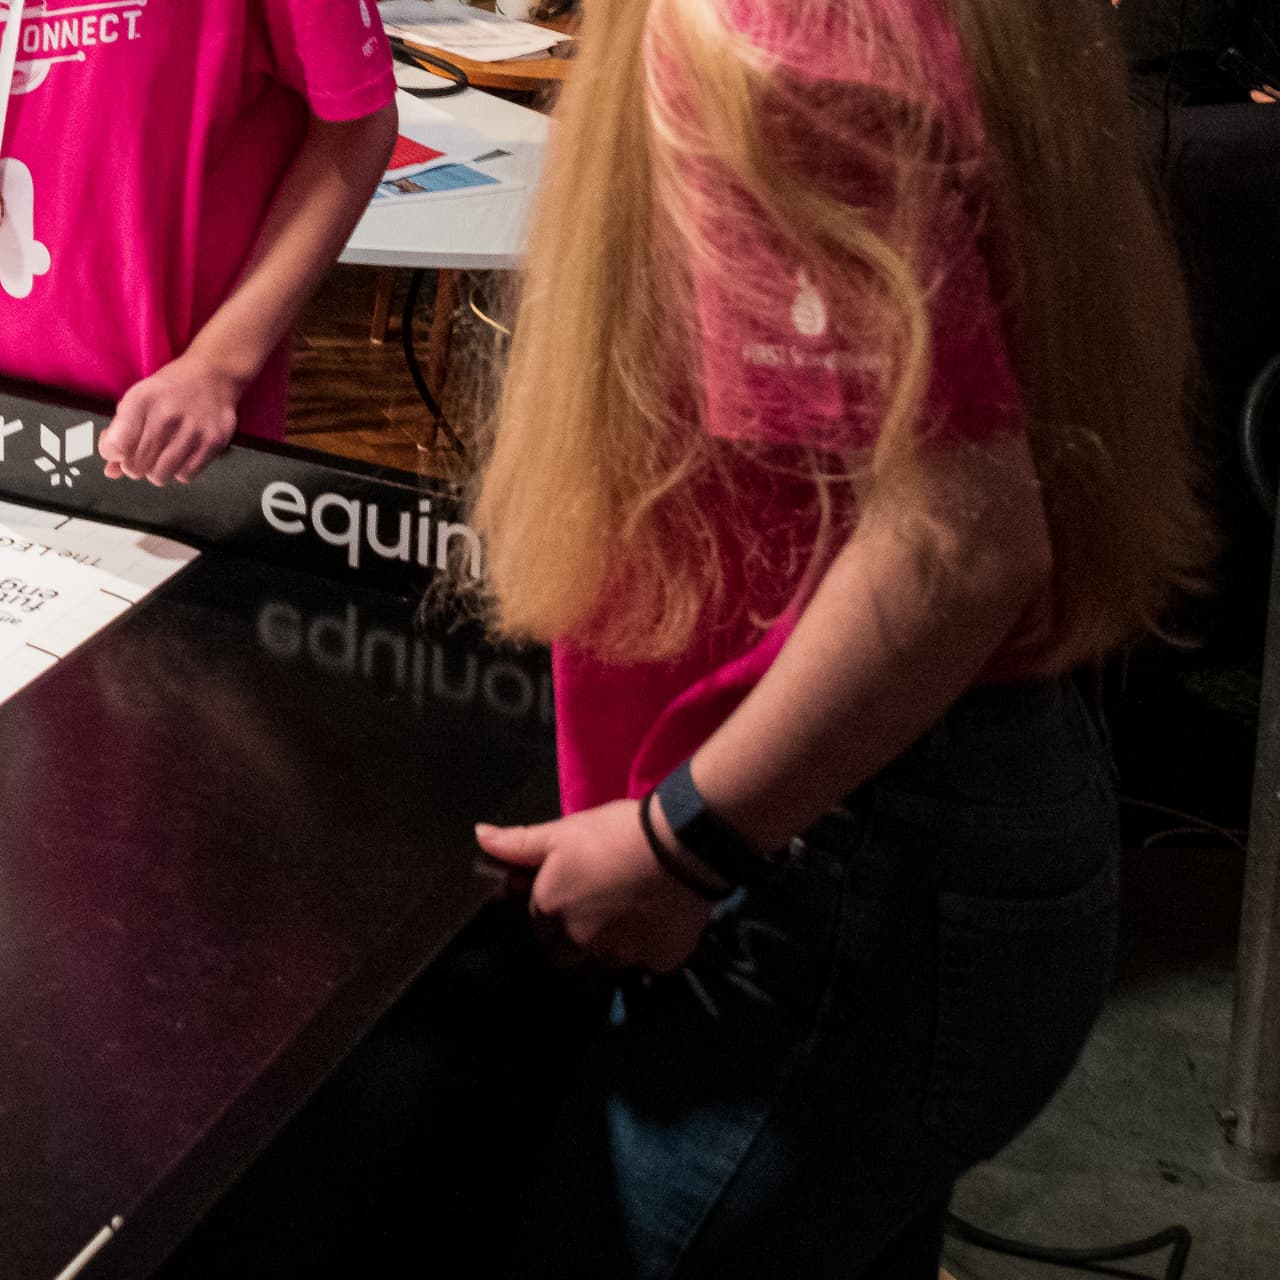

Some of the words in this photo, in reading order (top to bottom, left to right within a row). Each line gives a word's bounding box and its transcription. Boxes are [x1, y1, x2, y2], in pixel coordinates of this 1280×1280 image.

[22, 9, 142, 54] ONNECT
[261, 480, 483, 580] equin
[56, 549, 103, 568] The
